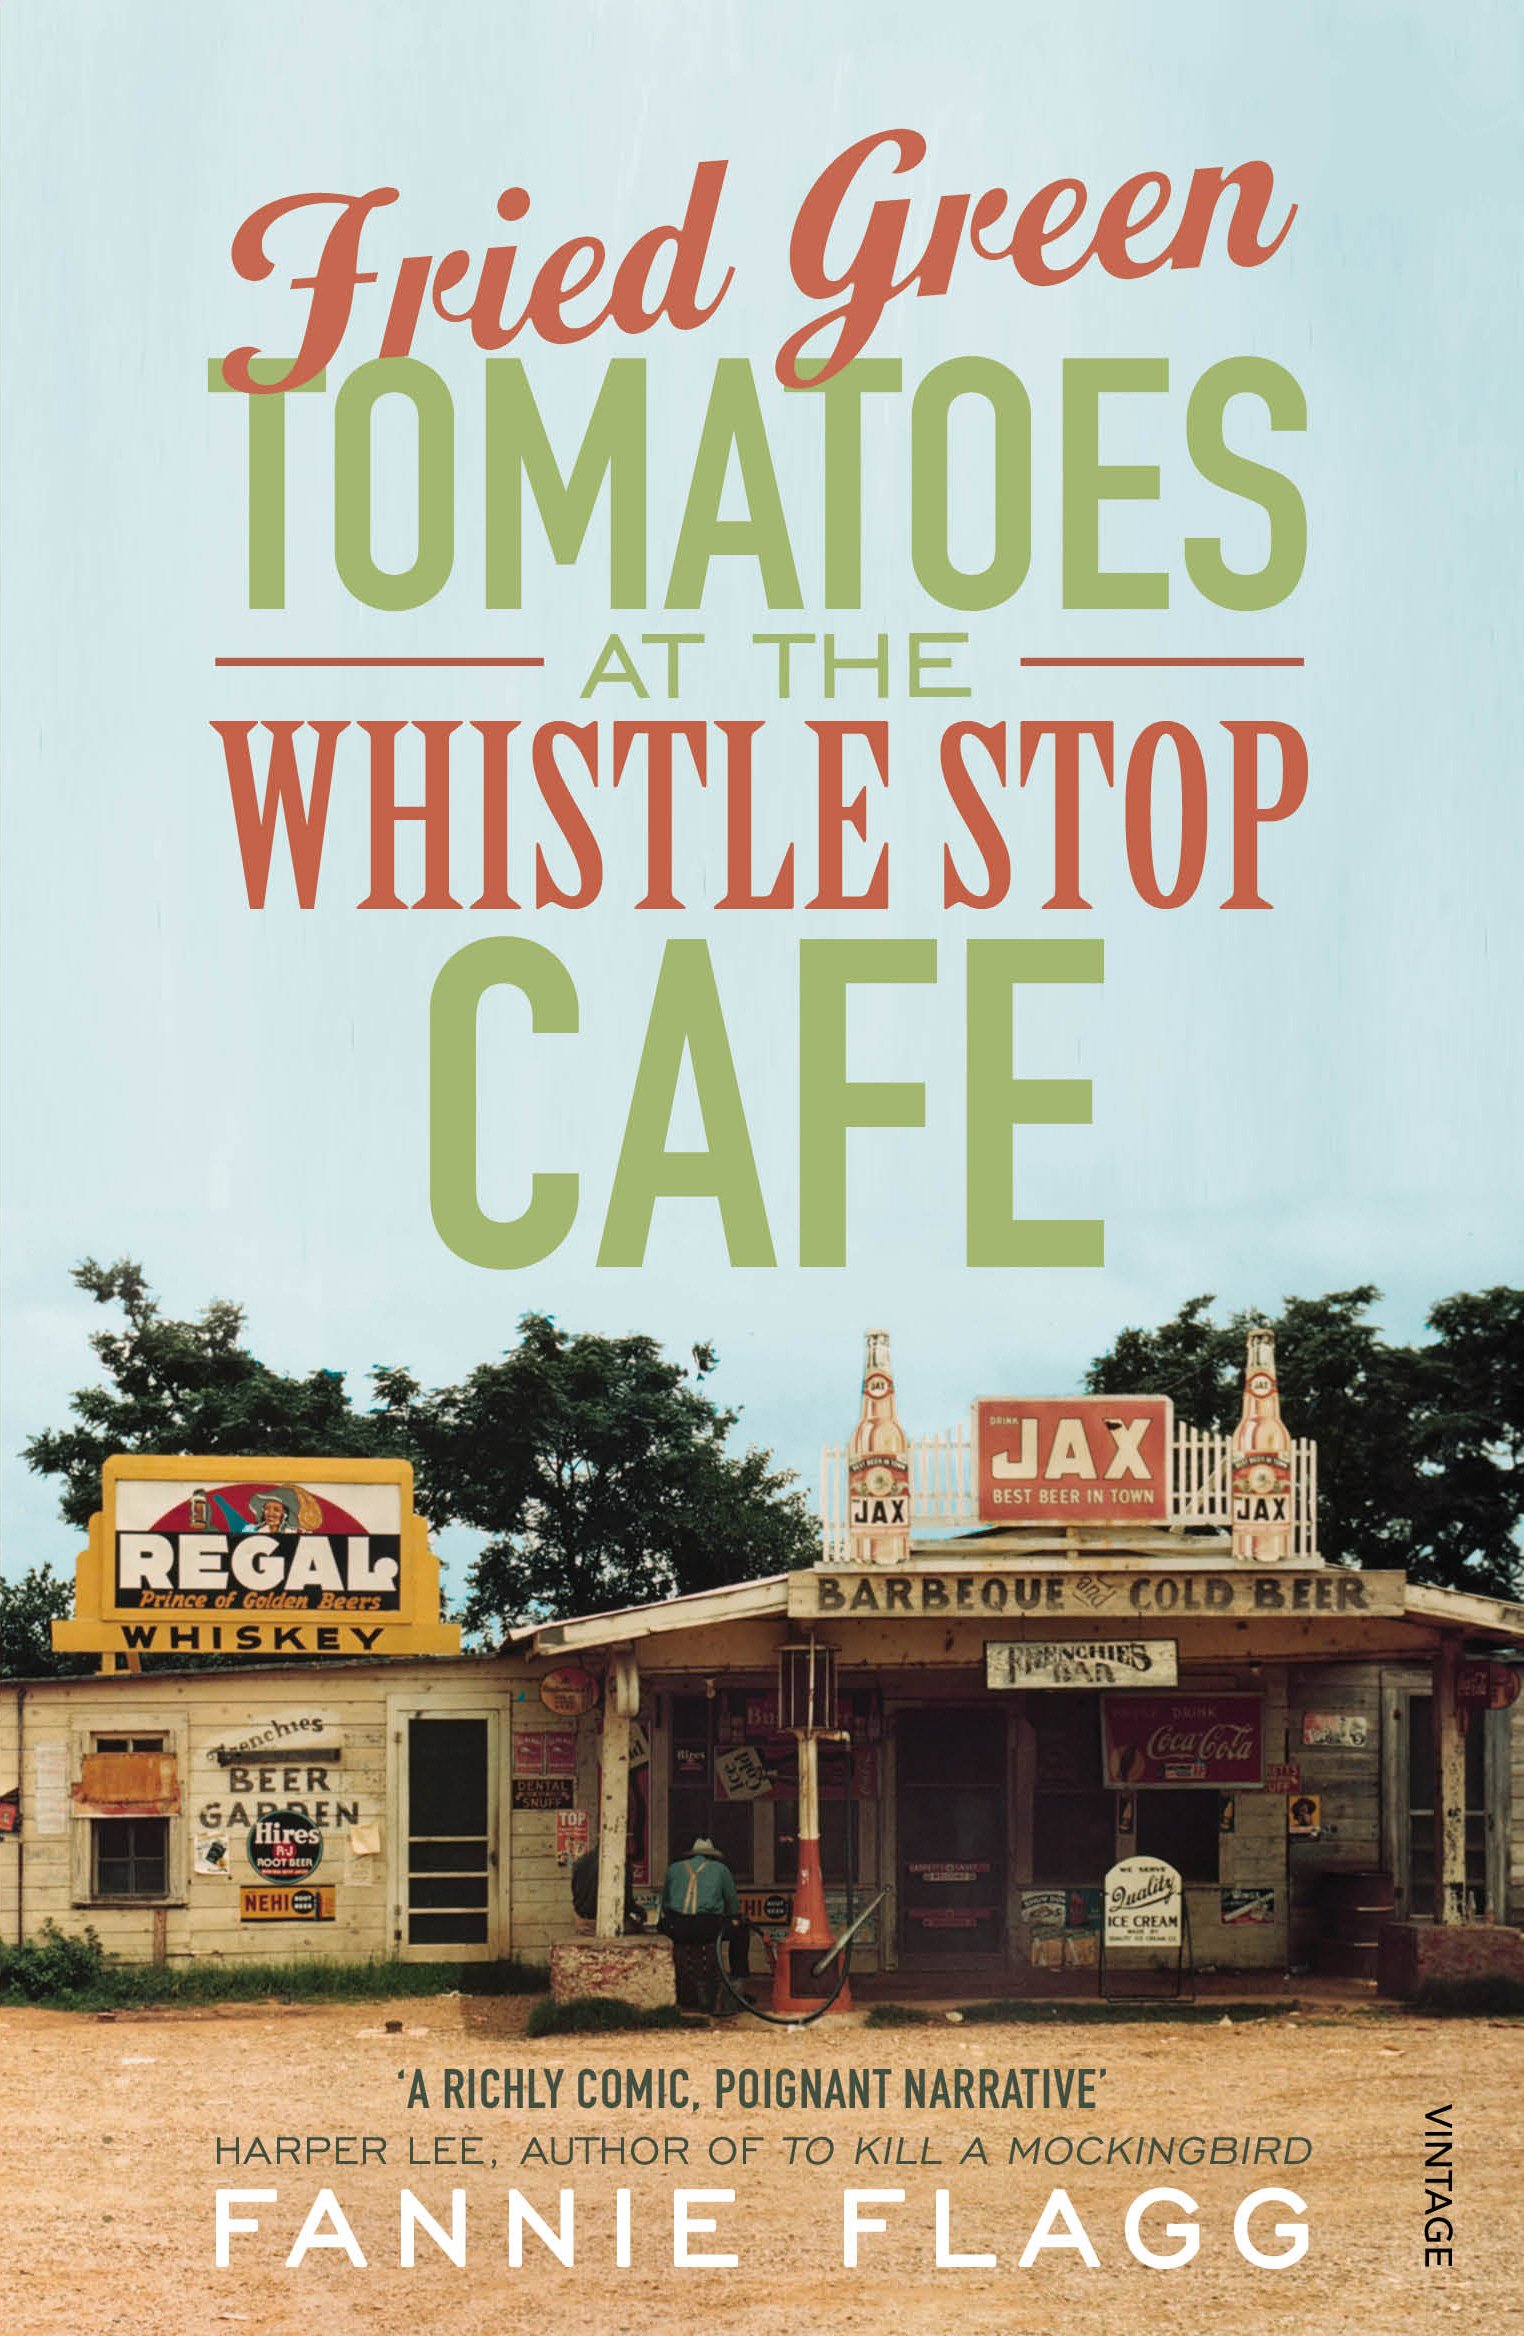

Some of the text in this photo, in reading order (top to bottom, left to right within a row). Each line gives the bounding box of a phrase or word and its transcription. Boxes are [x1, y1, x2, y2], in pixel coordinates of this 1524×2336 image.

[990, 1416, 1019, 1425] DRINK
[991, 1417, 1153, 1480] JAX
[993, 1488, 1155, 1504] BEST BEER IN TOWN
[853, 1499, 904, 1524] JAX
[1236, 1498, 1285, 1521] JAX
[118, 1534, 399, 1592] REGAL
[139, 1591, 382, 1610] Prince of Golden Beers
[818, 1575, 1370, 1611] BARBEQUE and COLD BEER
[121, 1626, 385, 1650] WHISKEY
[230, 1767, 330, 1792] BEER
[517, 1780, 568, 1792] DENTAL
[559, 1812, 586, 1826] TOP
[255, 1822, 320, 1845] Hires
[257, 1858, 313, 1867] ROOT BEER
[245, 1894, 289, 1912] NEHI
[1109, 1875, 1175, 1912] Quality
[1108, 1915, 1178, 1928] ICE CREAM
